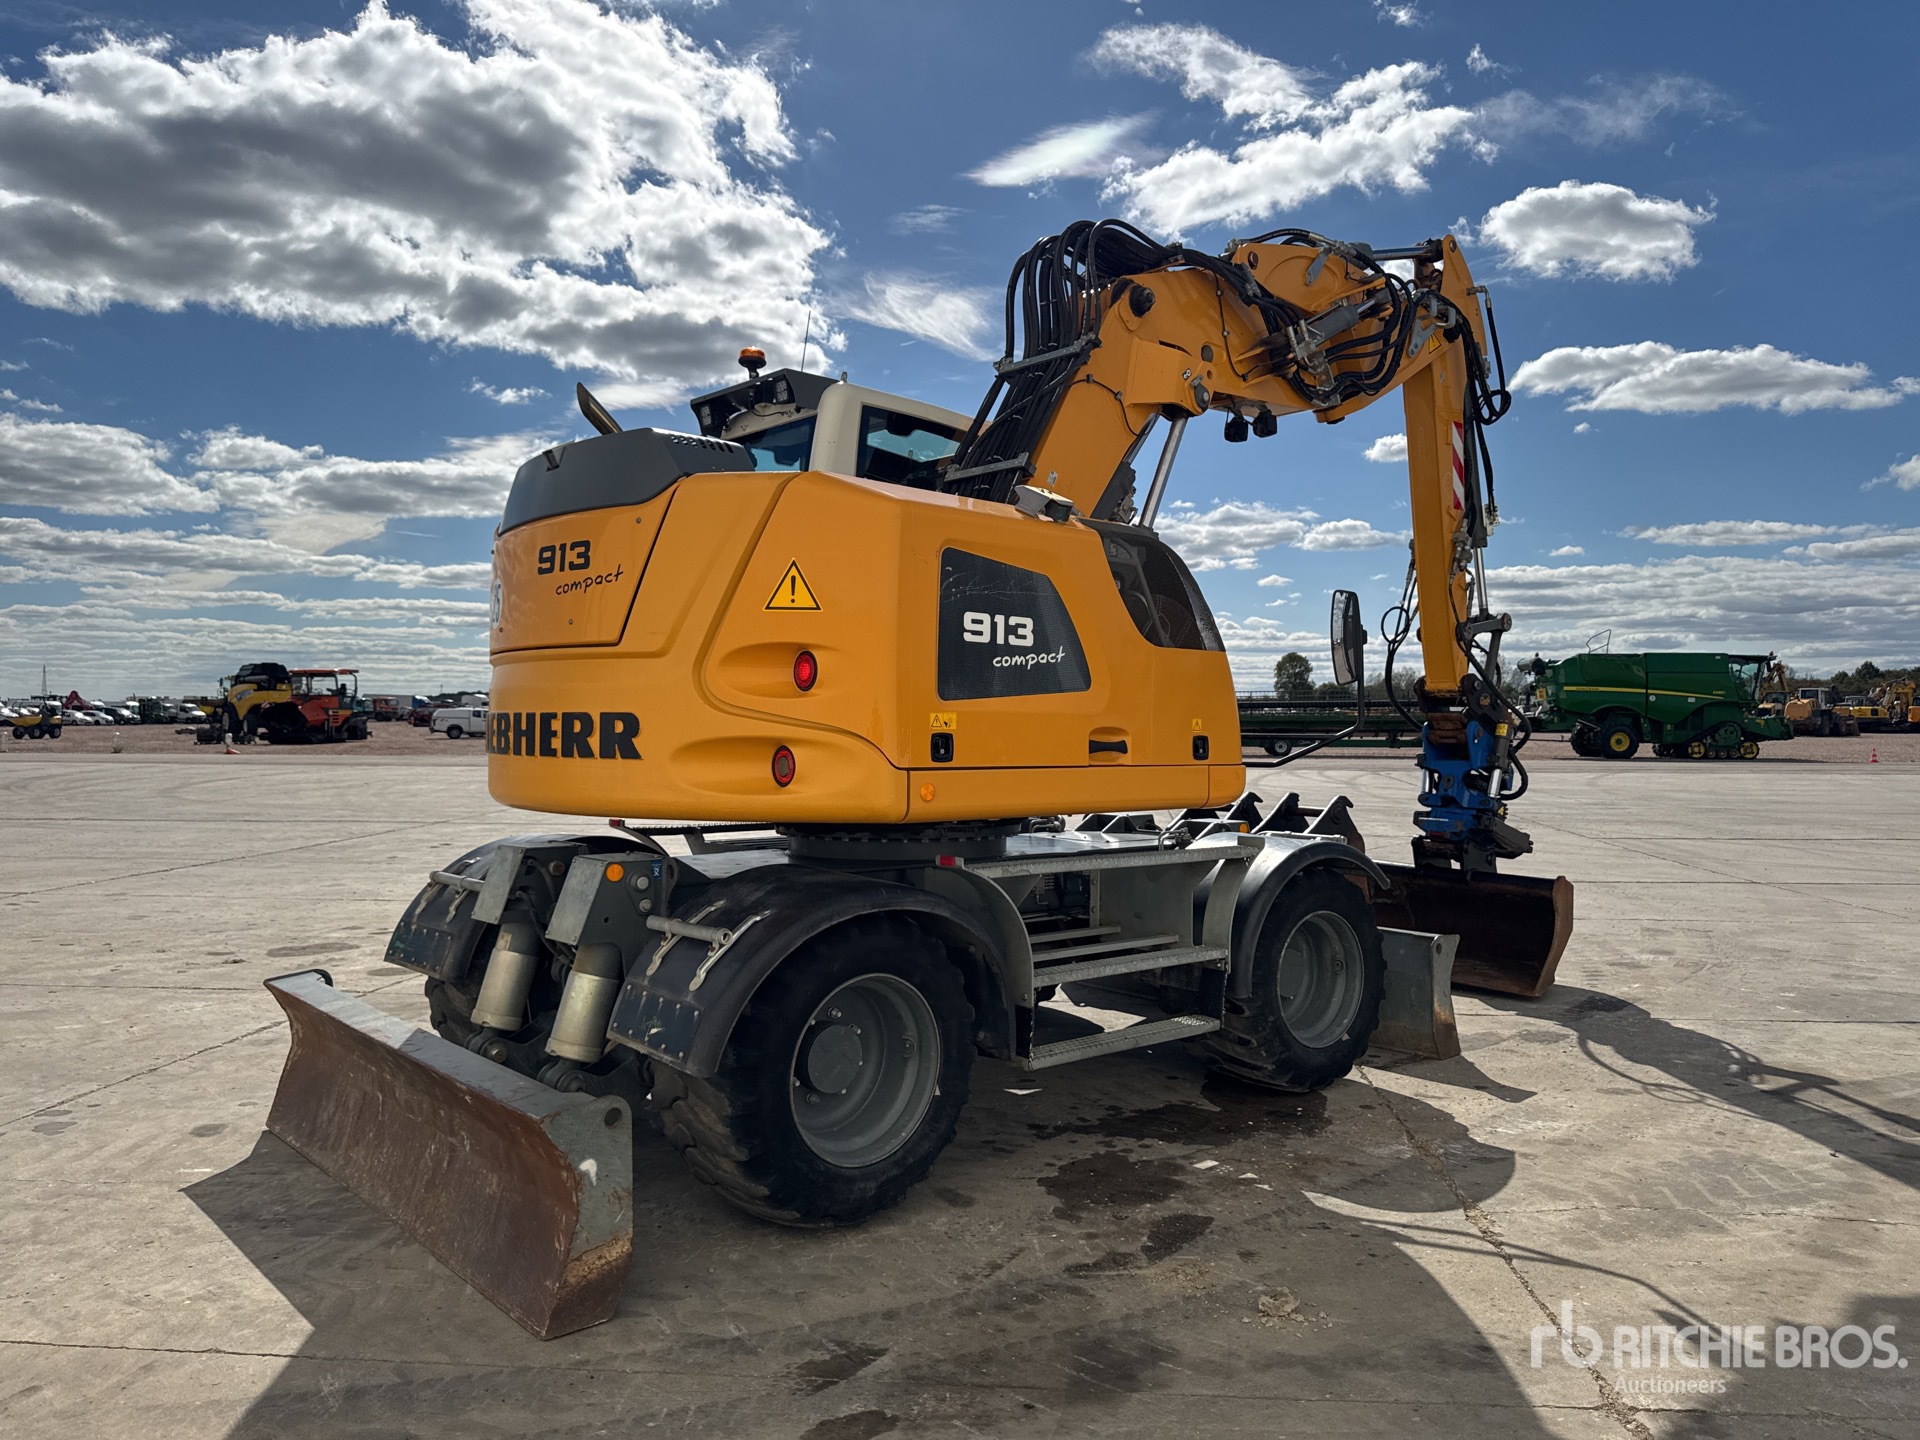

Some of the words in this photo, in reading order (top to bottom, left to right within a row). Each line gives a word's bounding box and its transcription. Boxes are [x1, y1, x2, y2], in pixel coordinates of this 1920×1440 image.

[537, 540, 591, 575] 913
[555, 564, 624, 595] compact
[963, 611, 1034, 647] 913
[993, 646, 1065, 669] compact
[486, 711, 643, 760] EBHERR
